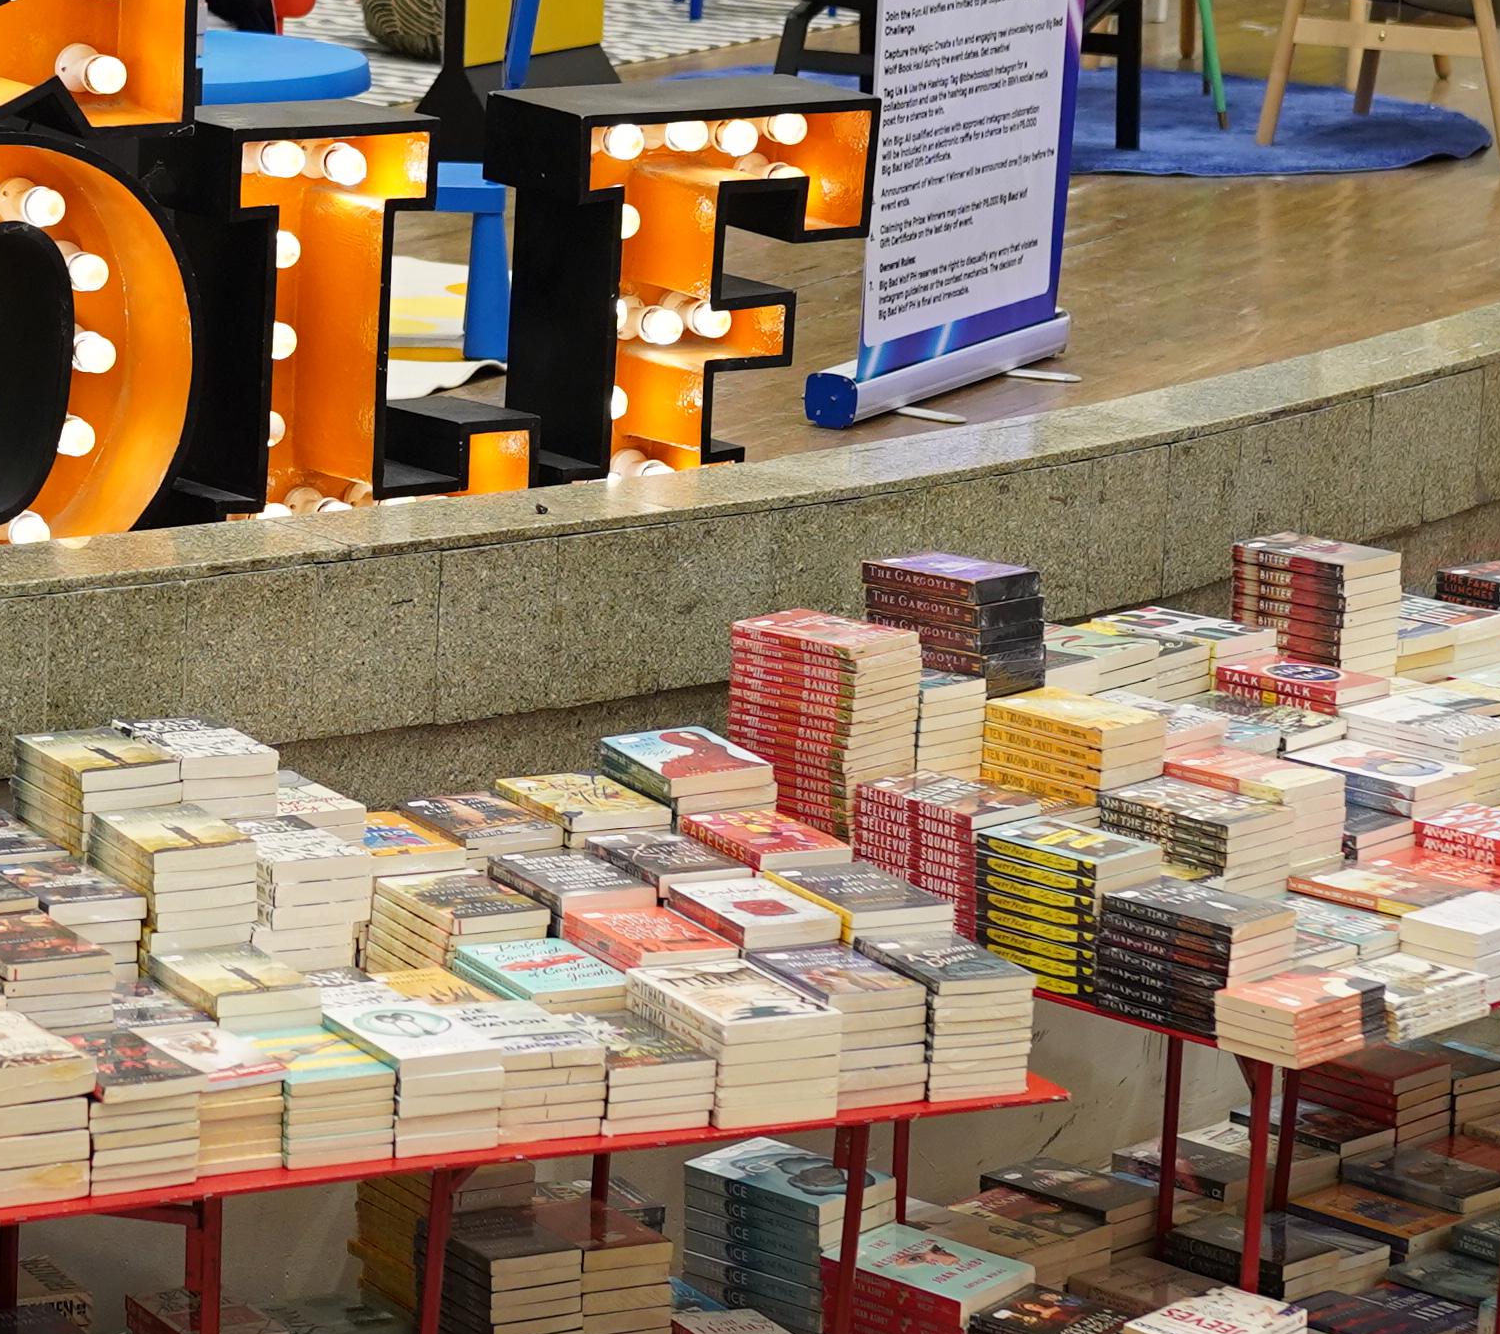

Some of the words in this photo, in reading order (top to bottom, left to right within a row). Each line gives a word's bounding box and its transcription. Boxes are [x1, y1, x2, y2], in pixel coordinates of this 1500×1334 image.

[1258, 552, 1291, 567] BITTER
[870, 566, 894, 580] THE
[894, 568, 956, 593] GARGOYLE
[1443, 572, 1462, 585] THE
[1465, 575, 1496, 592] FAME
[1444, 584, 1494, 600] LUNCHES
[800, 639, 834, 656] BANKS
[1225, 670, 1258, 688] TALK
[1277, 681, 1311, 697] TALK
[861, 785, 909, 810] BELLEVUE
[918, 803, 956, 825] SQUARE
[1101, 798, 1117, 810] ON
[1119, 801, 1143, 817] THE
[1145, 806, 1176, 825] EDGE
[681, 817, 746, 861] CARELESS
[727, 1180, 749, 1199] ICE
